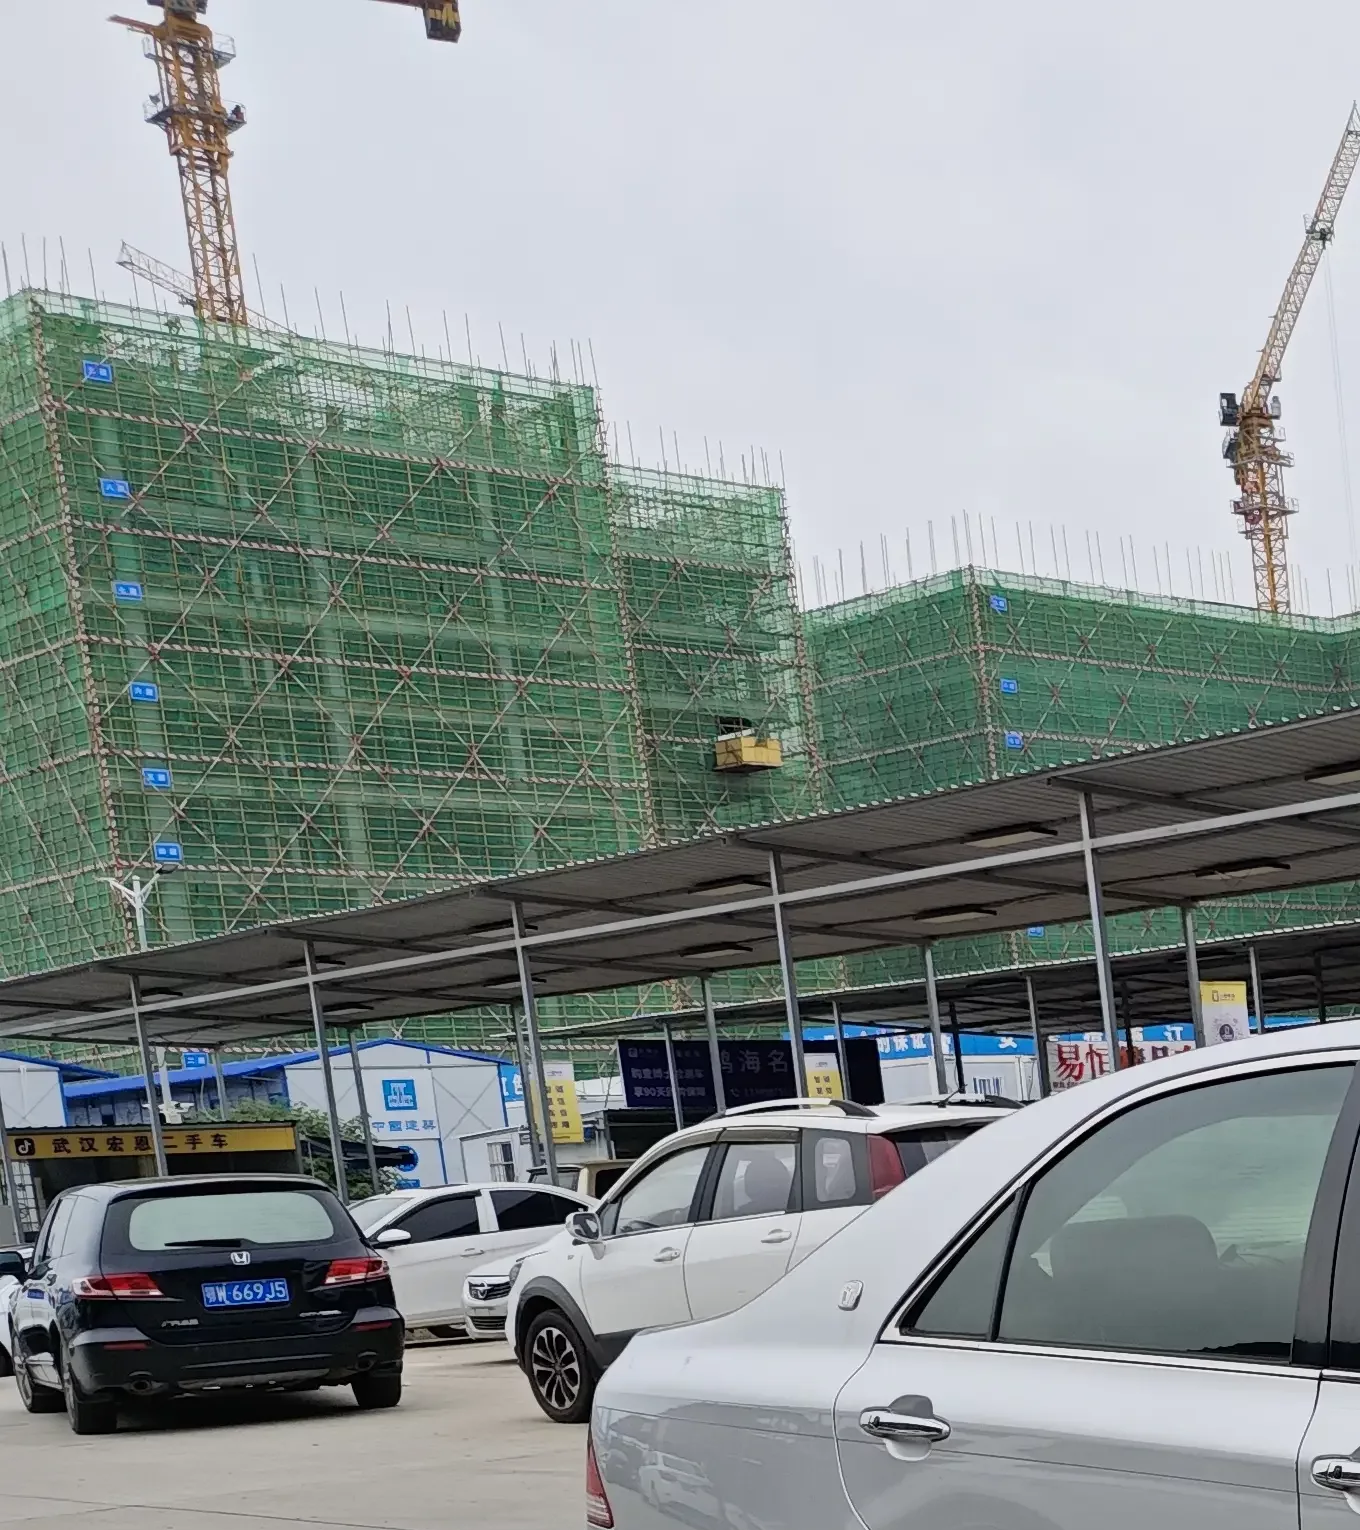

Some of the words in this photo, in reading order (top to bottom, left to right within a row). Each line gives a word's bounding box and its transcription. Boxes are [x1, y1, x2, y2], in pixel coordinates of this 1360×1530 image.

[52, 1133, 229, 1155] 武汉宏恩二手车
